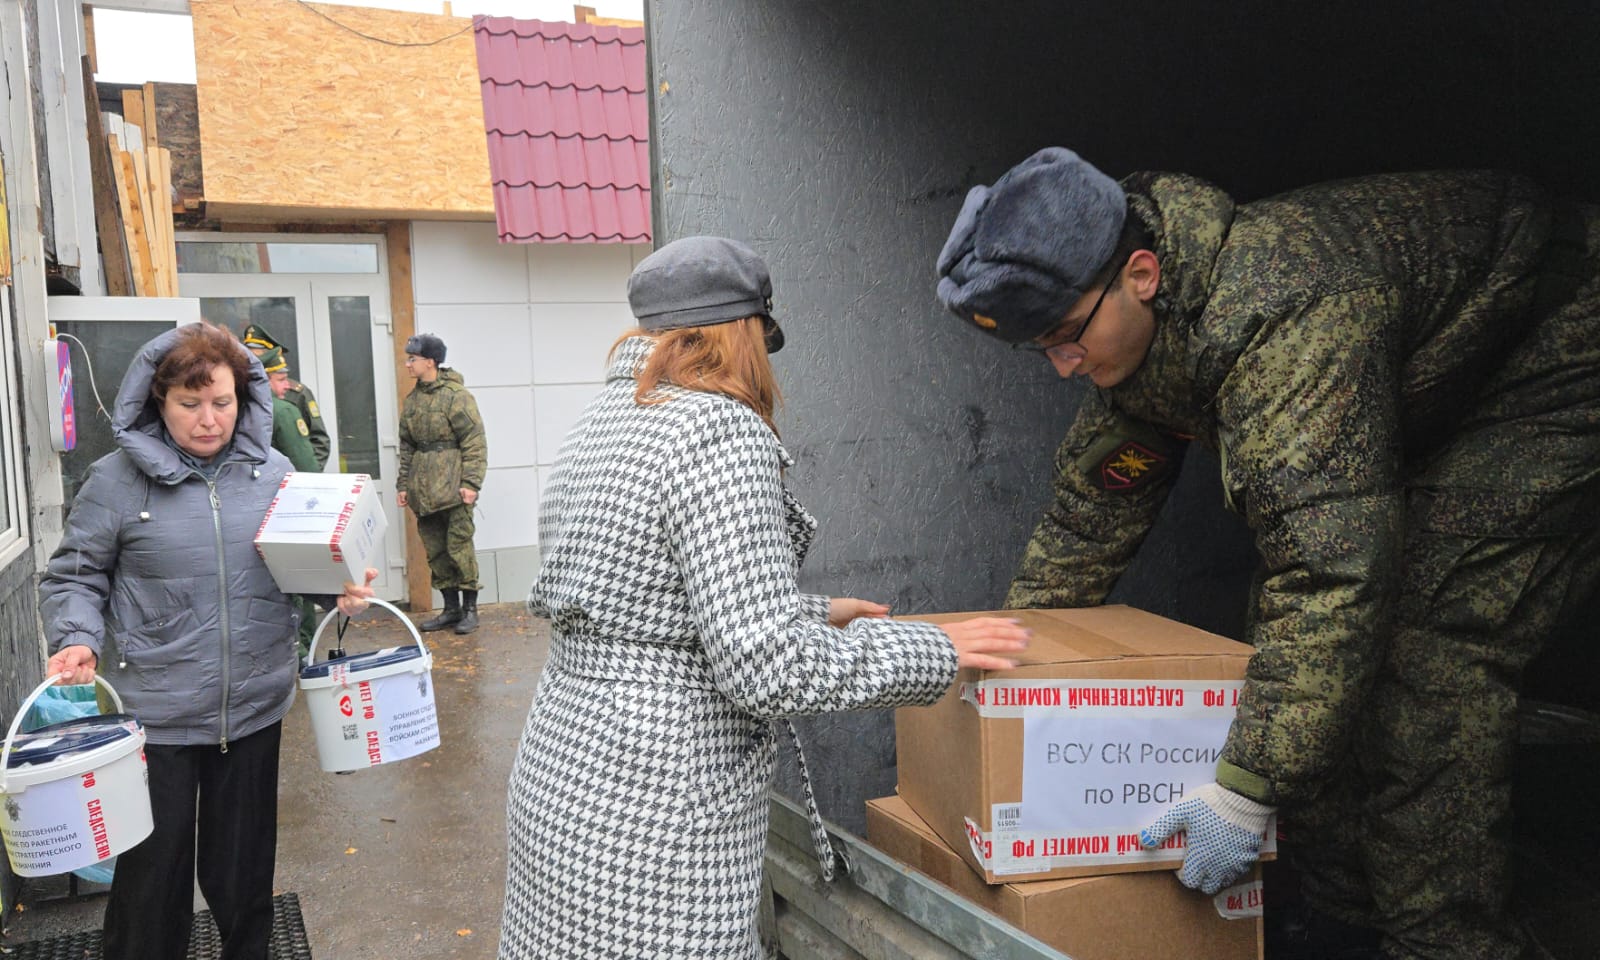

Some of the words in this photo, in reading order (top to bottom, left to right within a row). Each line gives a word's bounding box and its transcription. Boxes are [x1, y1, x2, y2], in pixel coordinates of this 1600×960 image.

[992, 687, 1061, 706] КОМИТЕТ
[1068, 686, 1184, 709] СЛЕДСТВЕННЫЙ
[1203, 688, 1225, 707] РФ
[362, 705, 375, 720] РФ
[366, 731, 381, 767] СЛЕДСТ
[1047, 742, 1094, 765] ВСУ
[1101, 742, 1131, 764] СК
[1140, 743, 1223, 764] России
[80, 771, 96, 789] РФ
[1084, 787, 1114, 805] по
[1122, 782, 1185, 805] РВСН
[12, 823, 69, 838] СЛЕДСТВЕННОЕ
[31, 832, 78, 847] РАКЕТНЫМ
[14, 842, 82, 858] СТРАТЕГИЧЕСКОГО
[1012, 839, 1035, 858] РФ
[1041, 835, 1110, 857] КОМИТЕТ
